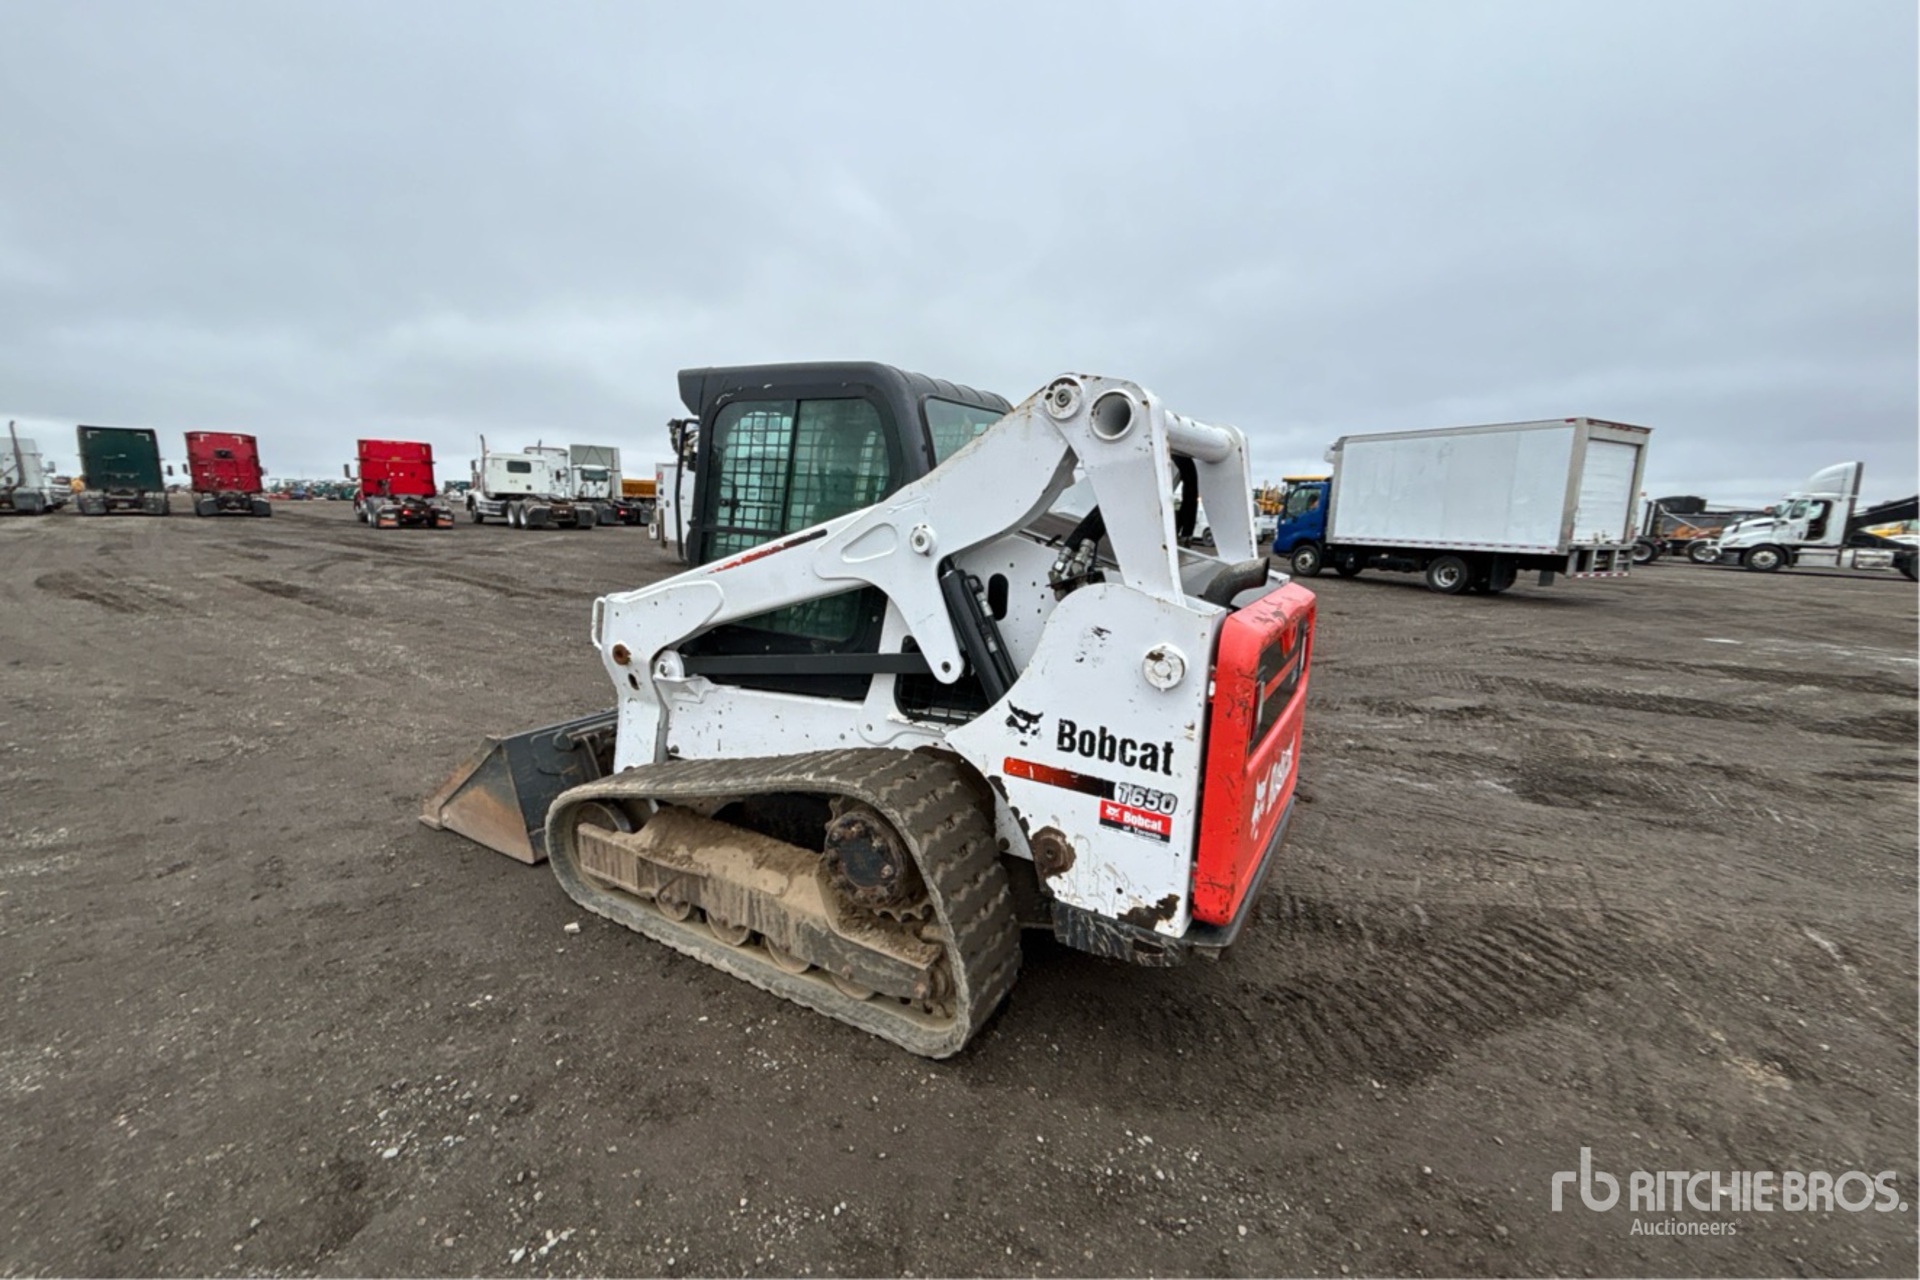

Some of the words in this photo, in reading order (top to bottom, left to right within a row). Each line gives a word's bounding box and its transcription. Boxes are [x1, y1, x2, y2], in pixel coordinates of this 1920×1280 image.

[1057, 718, 1174, 776] Bobcat
[1118, 781, 1178, 816] T650
[1123, 811, 1162, 832] Bobcat
